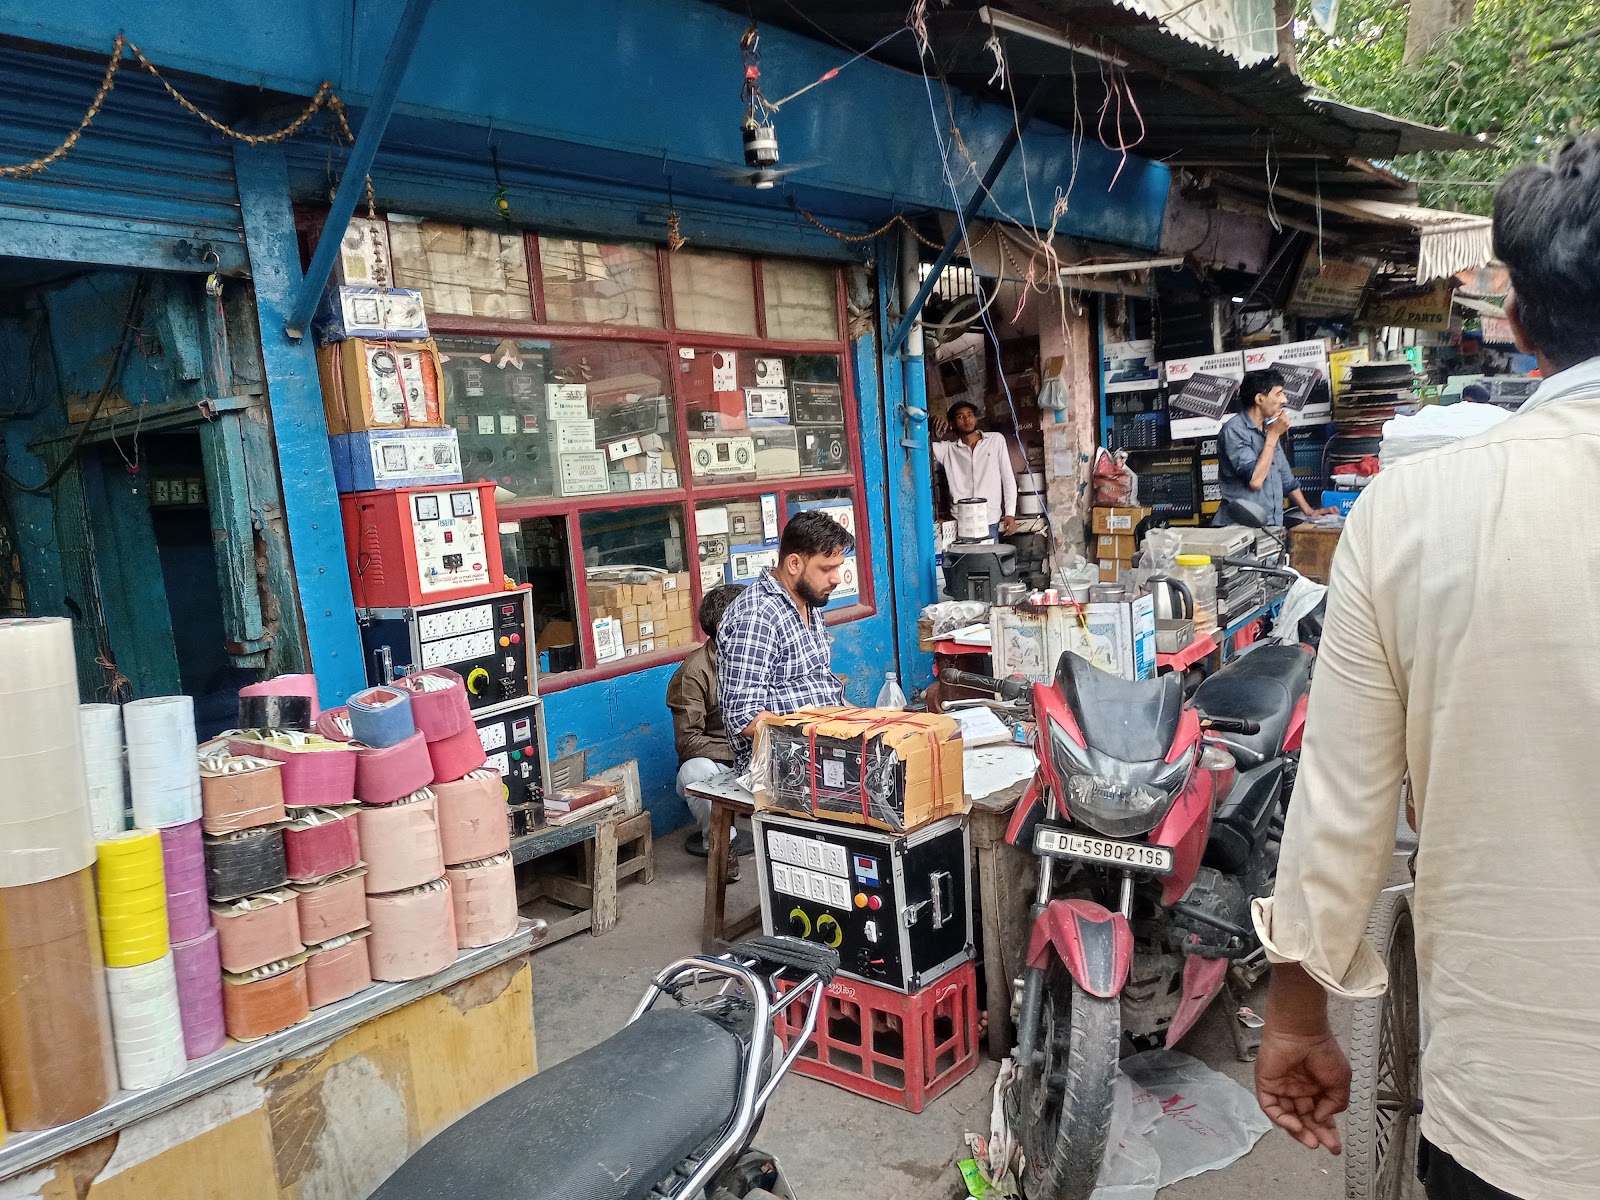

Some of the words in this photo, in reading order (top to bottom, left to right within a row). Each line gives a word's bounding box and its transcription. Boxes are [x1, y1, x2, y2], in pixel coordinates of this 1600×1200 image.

[1407, 312, 1443, 323] PARTS
[1283, 344, 1321, 354] PROFESSIONAL
[1059, 835, 1077, 852] DL
